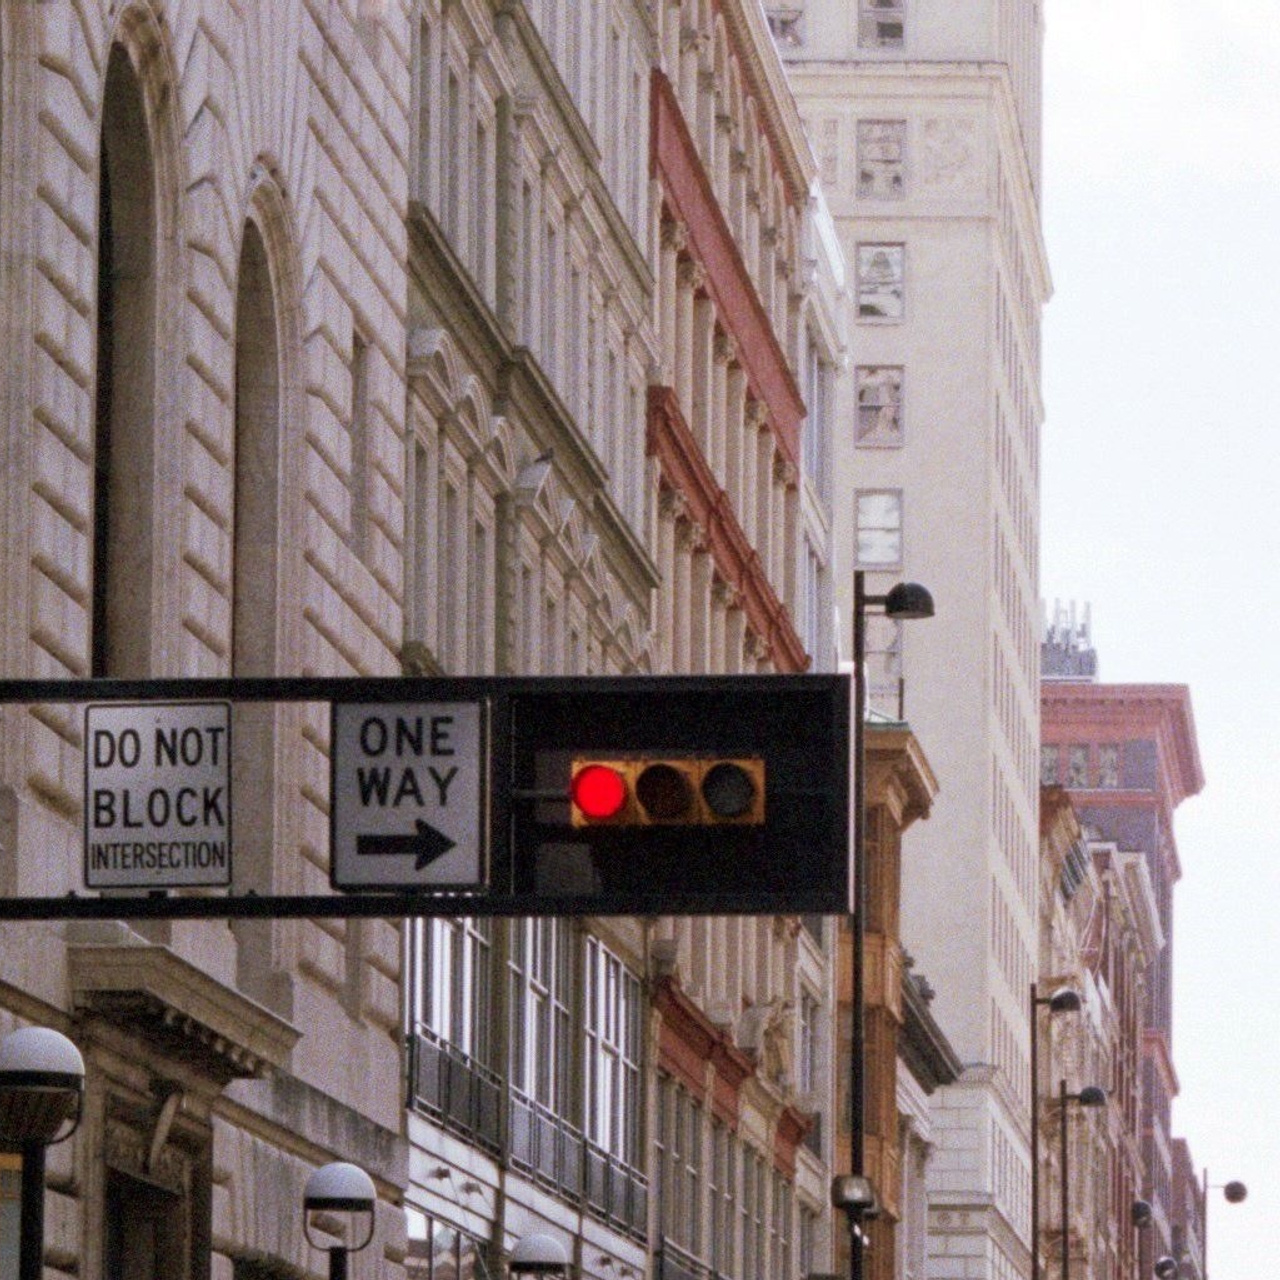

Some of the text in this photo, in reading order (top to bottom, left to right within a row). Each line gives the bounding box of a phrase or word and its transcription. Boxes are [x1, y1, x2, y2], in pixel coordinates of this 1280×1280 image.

[94, 727, 225, 768] DO NOT
[360, 716, 454, 756] ONE
[357, 766, 459, 807] WAY
[93, 787, 225, 829] BLOCK
[91, 841, 226, 870] INTERSECTION
